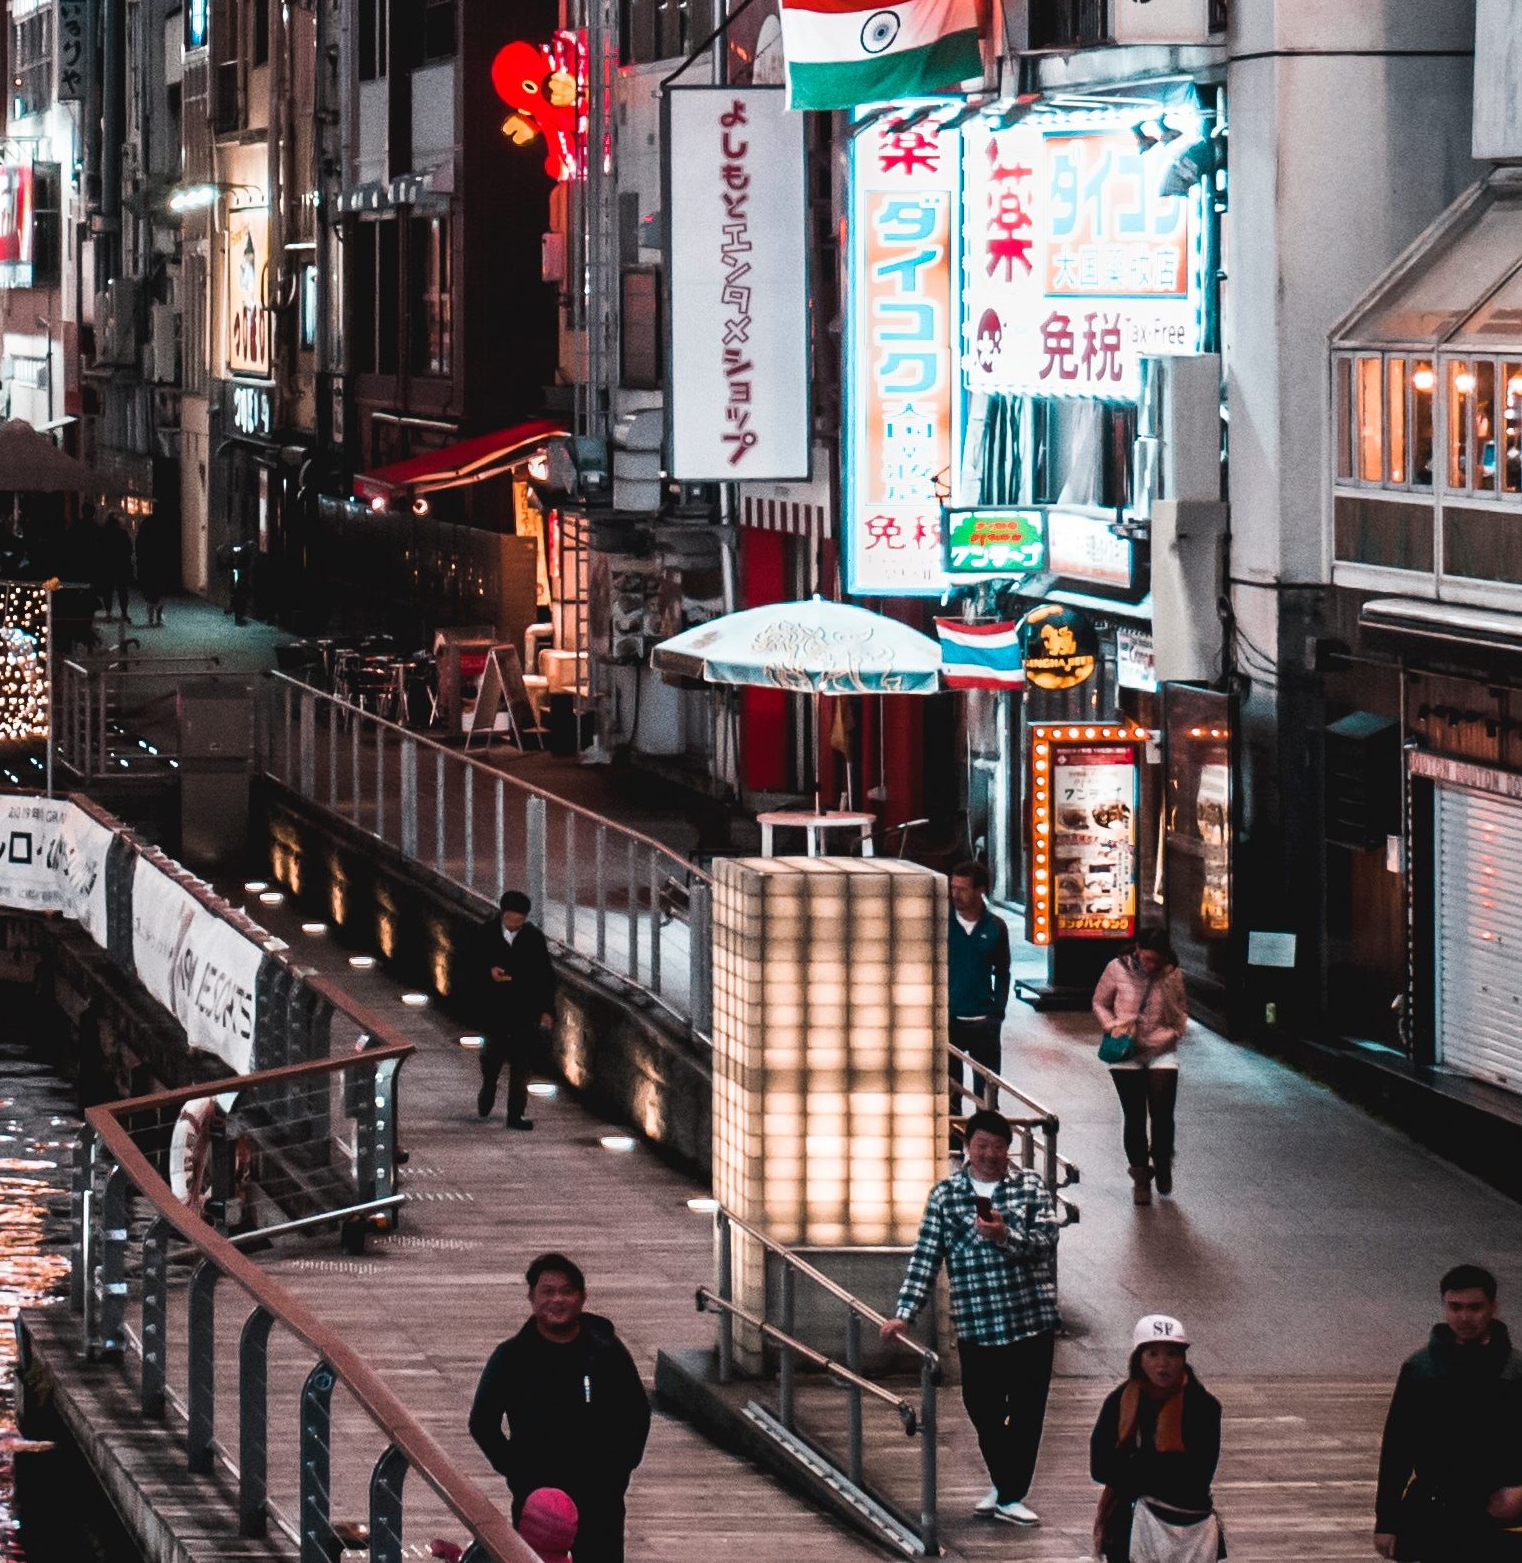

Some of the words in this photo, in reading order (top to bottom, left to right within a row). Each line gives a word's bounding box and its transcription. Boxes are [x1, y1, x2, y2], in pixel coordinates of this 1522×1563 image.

[720, 100, 759, 467] よしもとエンタメショップ
[875, 198, 941, 395] ダイコク
[1038, 310, 1124, 382] 免税
